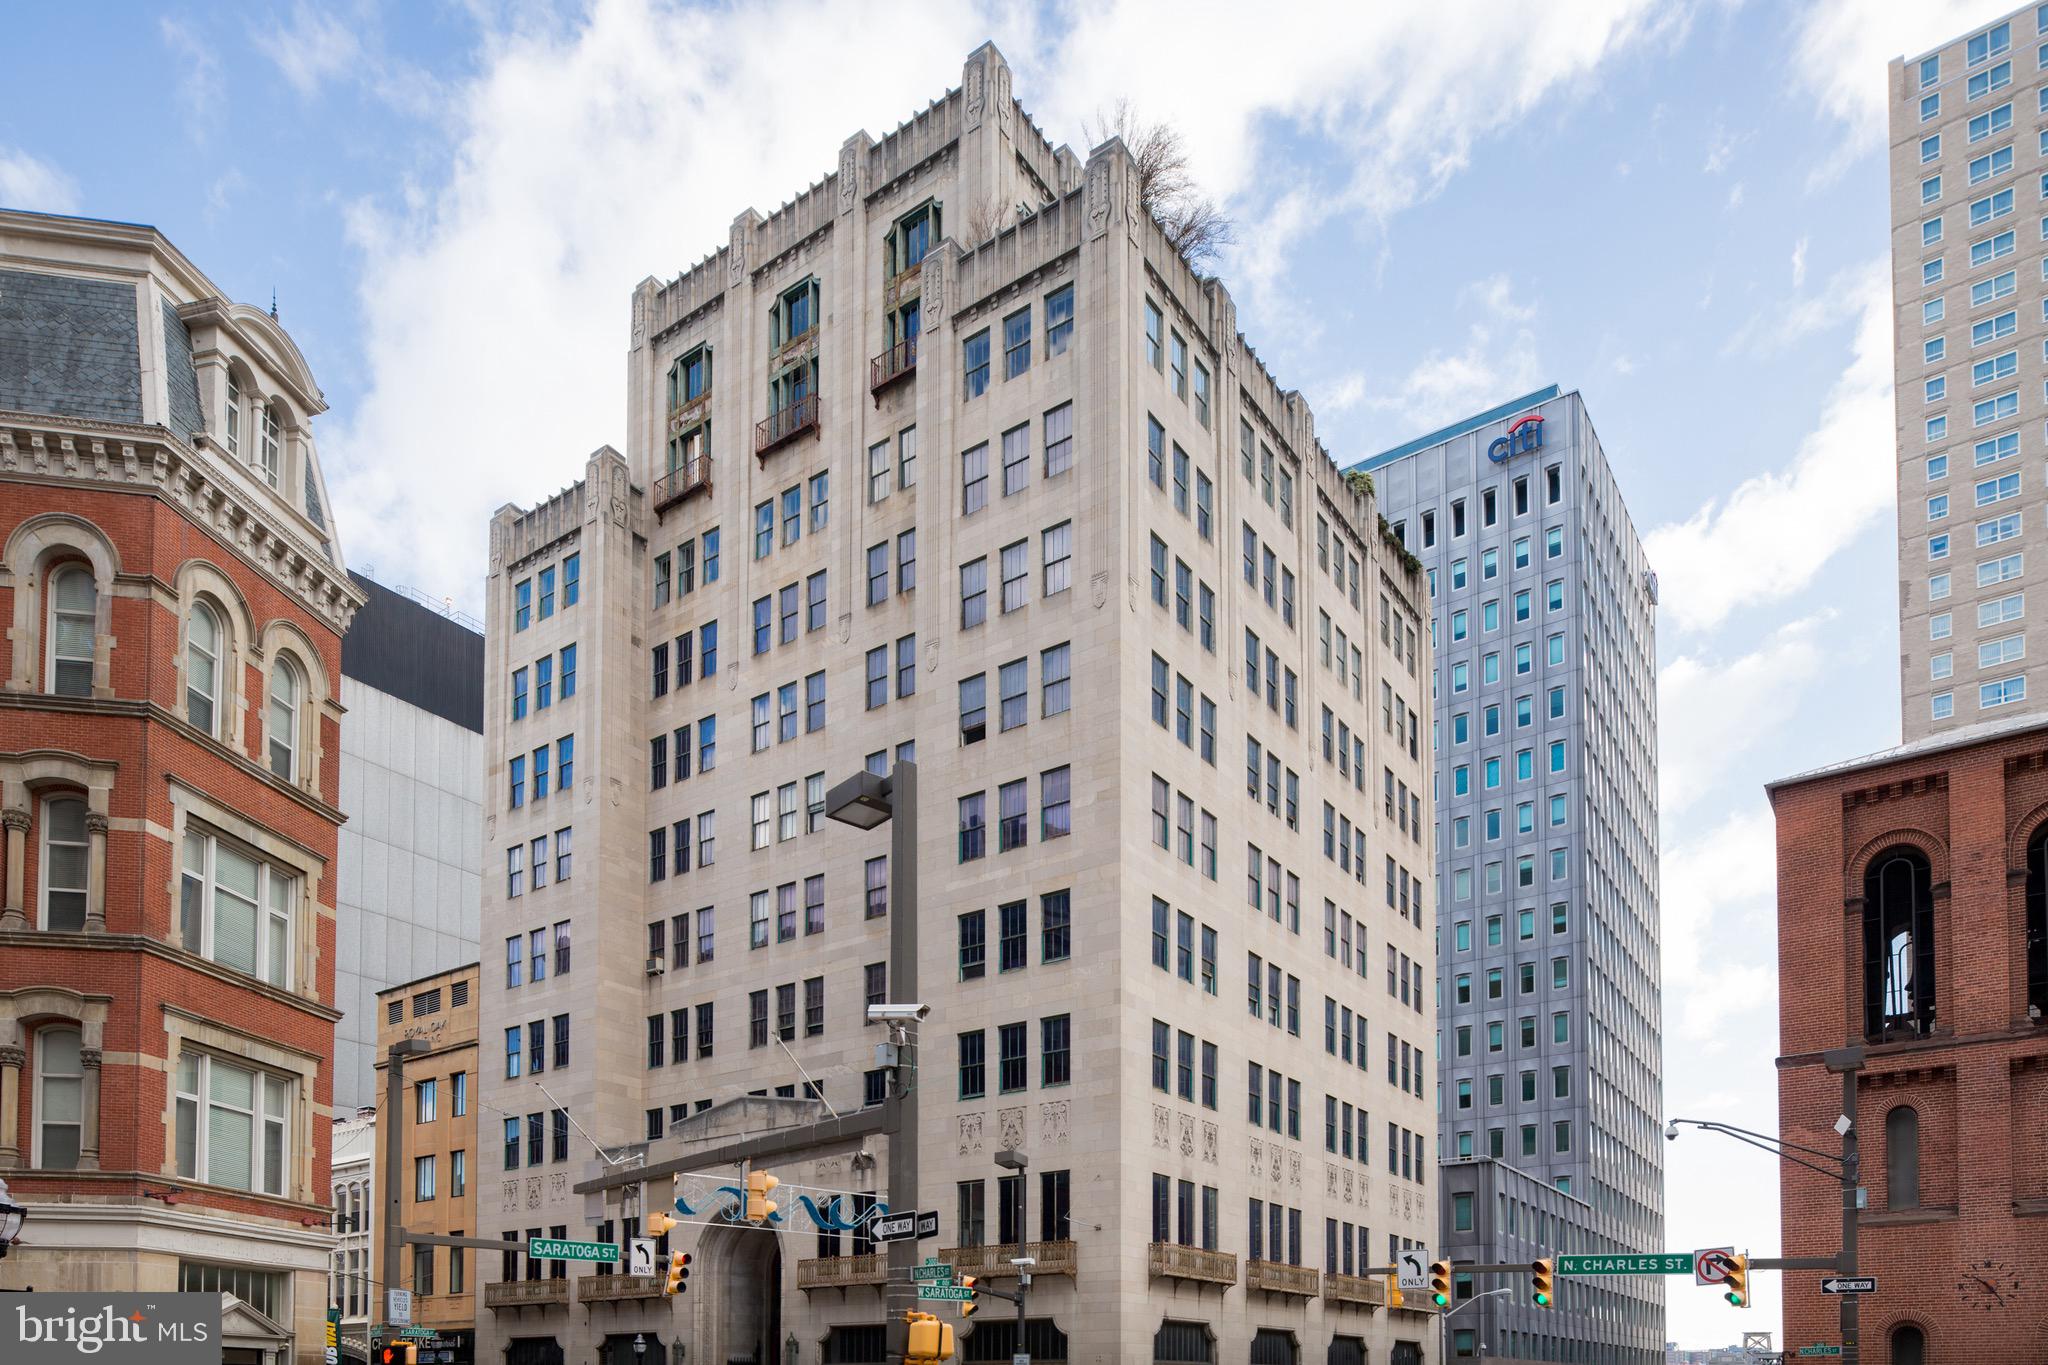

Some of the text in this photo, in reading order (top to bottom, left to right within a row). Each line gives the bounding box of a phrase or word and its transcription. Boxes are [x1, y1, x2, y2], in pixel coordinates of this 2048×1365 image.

[1488, 415, 1544, 463] citi
[882, 1220, 911, 1234] ONE WAY
[920, 1219, 934, 1232] WAY
[534, 1241, 616, 1259] SARATOGA ST.
[634, 1265, 652, 1274] ONLY
[1564, 1258, 1687, 1271] N. CHARLES ST.
[919, 1267, 945, 1279] CHARLES
[1401, 1278, 1424, 1287] ONLY
[917, 1287, 925, 1299] W
[925, 1287, 963, 1299] SARATOGA
[393, 1303, 408, 1312] YIELD
[1803, 1347, 1831, 1355] CHARLES
